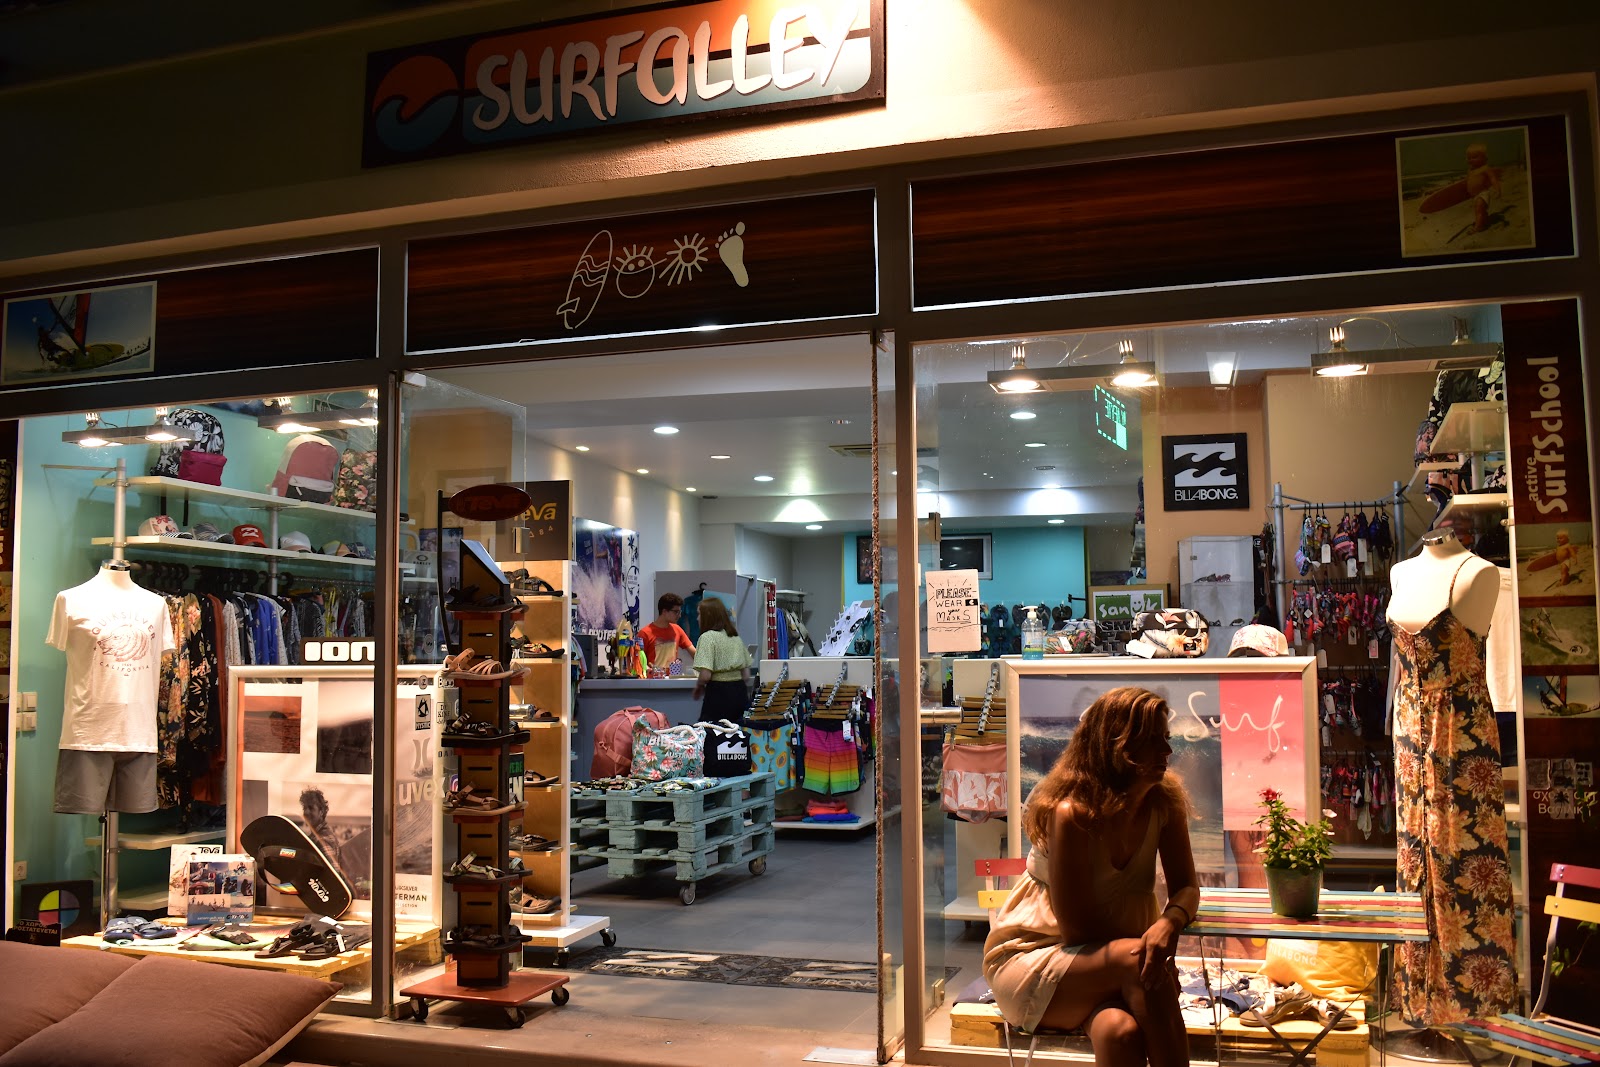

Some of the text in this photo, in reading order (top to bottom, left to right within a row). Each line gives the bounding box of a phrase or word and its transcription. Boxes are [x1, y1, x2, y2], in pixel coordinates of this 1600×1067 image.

[1525, 456, 1539, 502] active
[513, 502, 557, 521] eva
[935, 587, 972, 599] PLEASE
[935, 599, 963, 608] WEAR
[91, 611, 156, 640] QUIKSILVER
[99, 661, 149, 673] CALIFORNIA
[717, 753, 748, 761] BILLABONG
[399, 776, 446, 805] uvex
[395, 893, 427, 902] TERMAN
